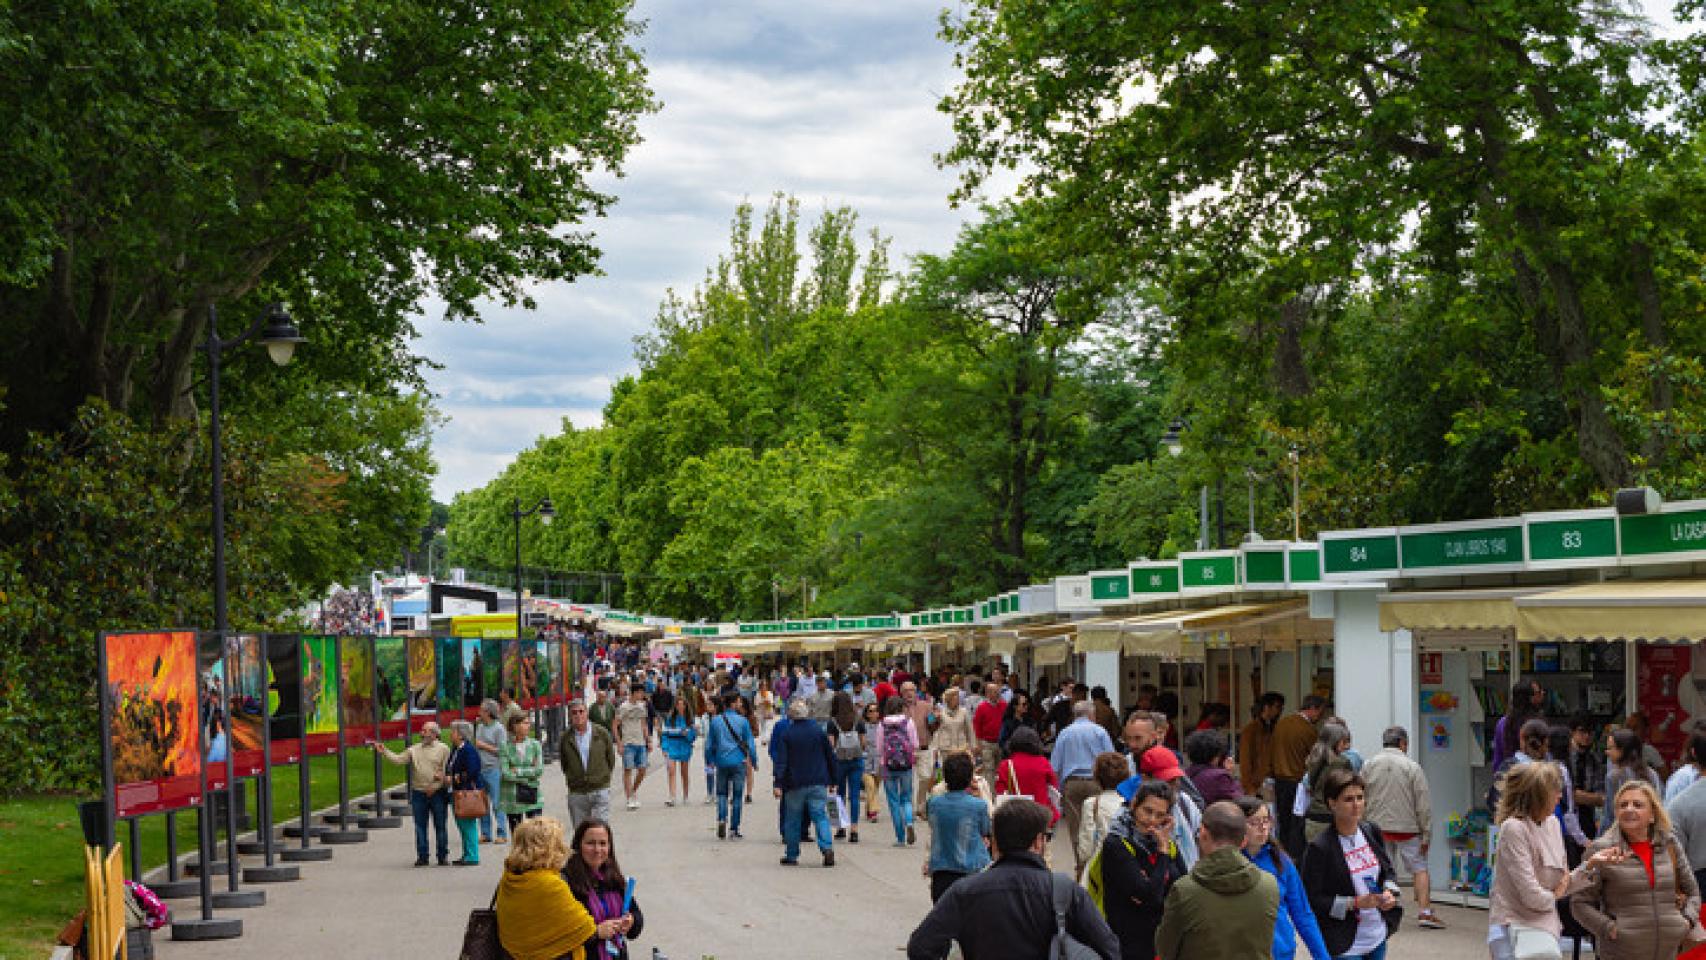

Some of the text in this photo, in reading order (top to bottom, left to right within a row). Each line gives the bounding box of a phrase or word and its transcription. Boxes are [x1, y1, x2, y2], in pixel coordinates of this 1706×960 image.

[1563, 530, 1582, 549] 83
[1670, 522, 1683, 541] LA
[1350, 546, 1368, 562] 84
